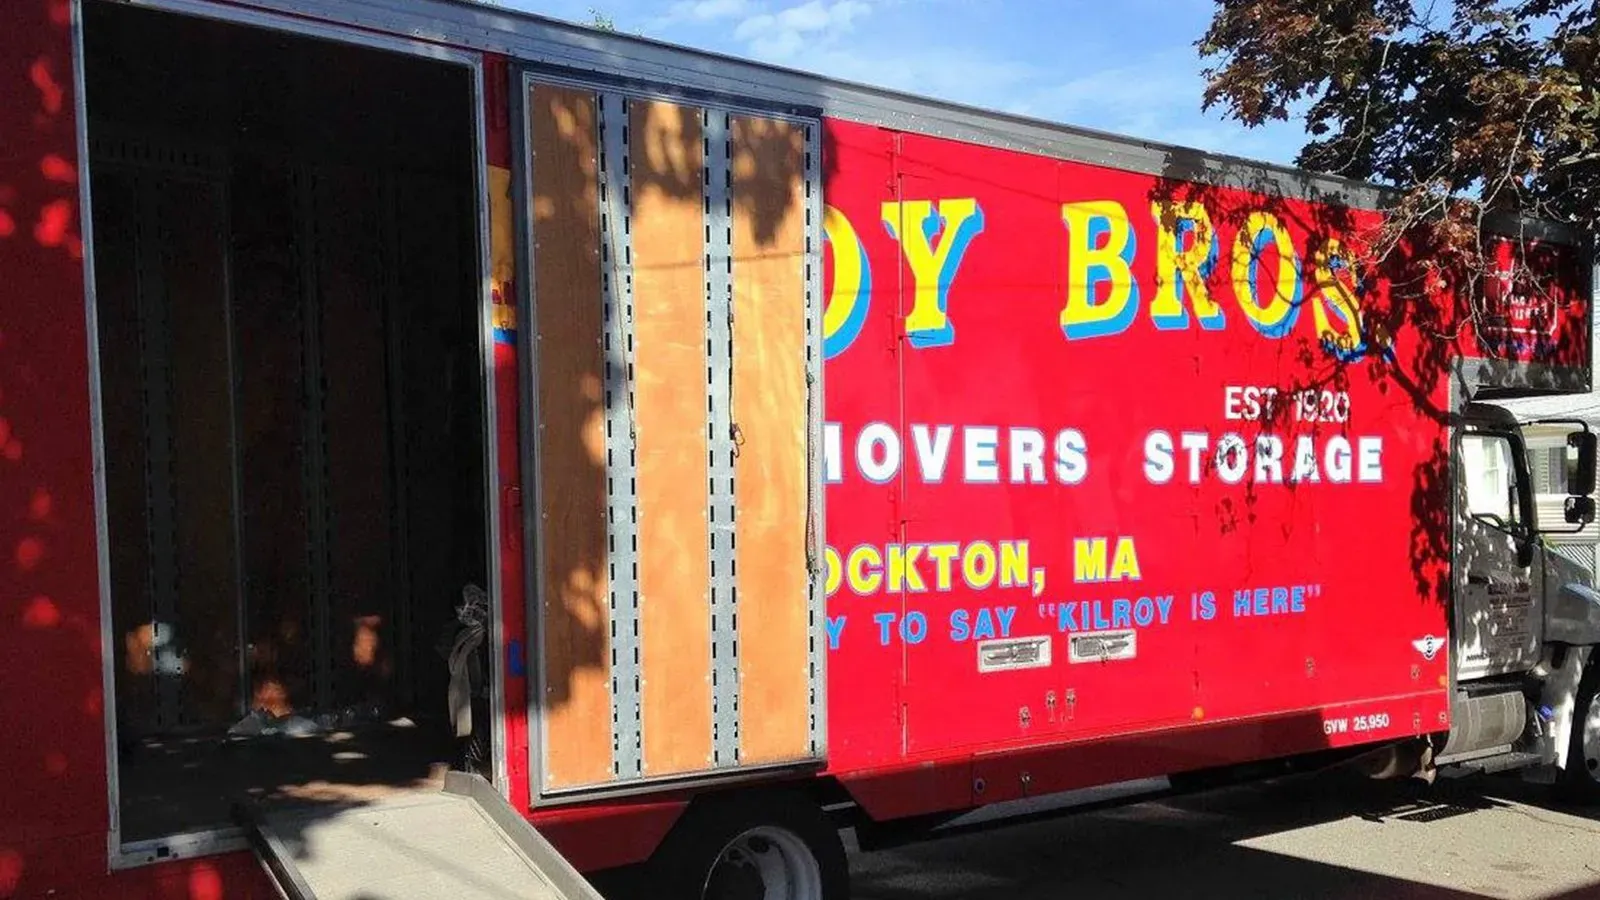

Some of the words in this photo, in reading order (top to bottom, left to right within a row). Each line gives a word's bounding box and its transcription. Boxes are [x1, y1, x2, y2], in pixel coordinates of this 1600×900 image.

[1225, 386, 1278, 421] EST
[1143, 433, 1384, 484] STORAGE
[1073, 536, 1140, 582] MA
[874, 611, 927, 644] TO
[951, 606, 1016, 641] SAY
[1191, 590, 1217, 621] IS
[1323, 718, 1348, 734] GVW
[1353, 714, 1390, 732] 25,950
